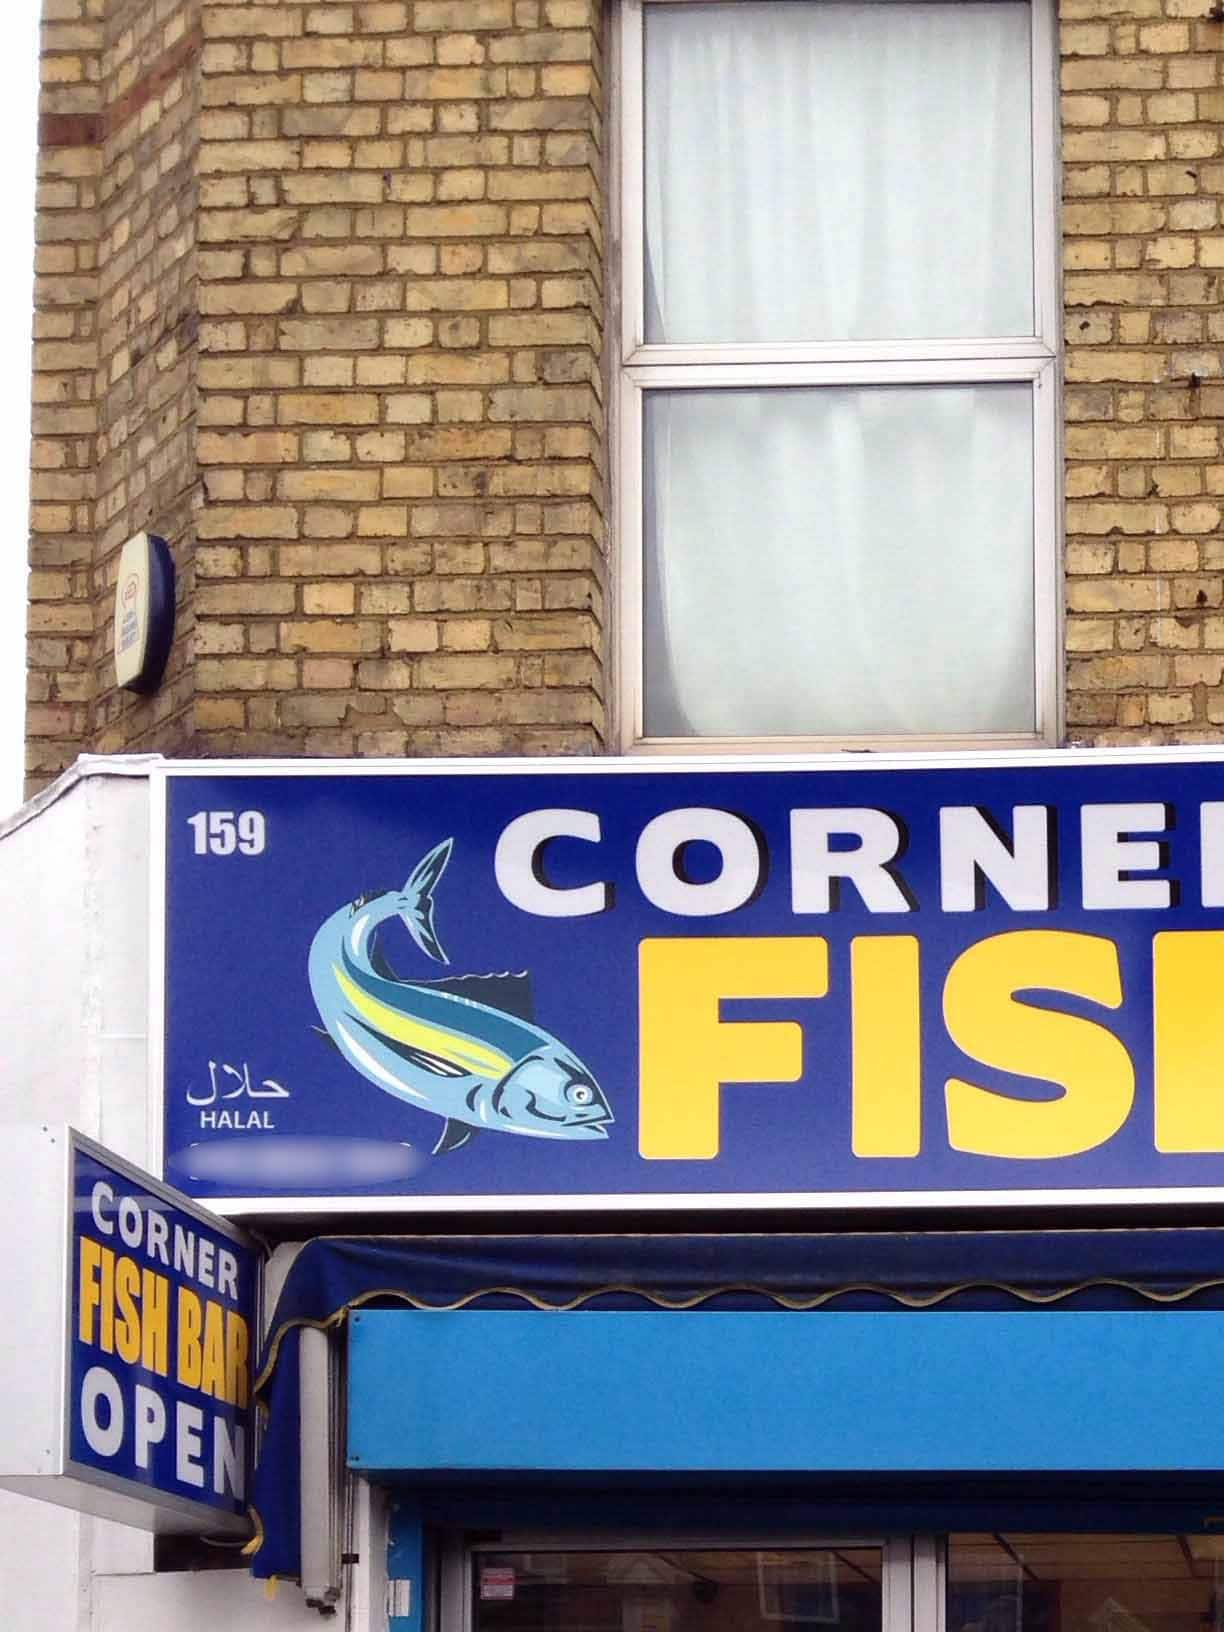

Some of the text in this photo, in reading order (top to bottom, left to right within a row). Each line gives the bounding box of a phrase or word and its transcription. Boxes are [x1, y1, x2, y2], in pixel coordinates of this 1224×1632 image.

[187, 810, 266, 855] 159
[186, 1060, 290, 1106] حلال
[200, 1109, 275, 1130] HALAL
[91, 1180, 239, 1301] CORNER
[79, 1235, 249, 1410] FISH BAR
[80, 1366, 244, 1501] OPEN
